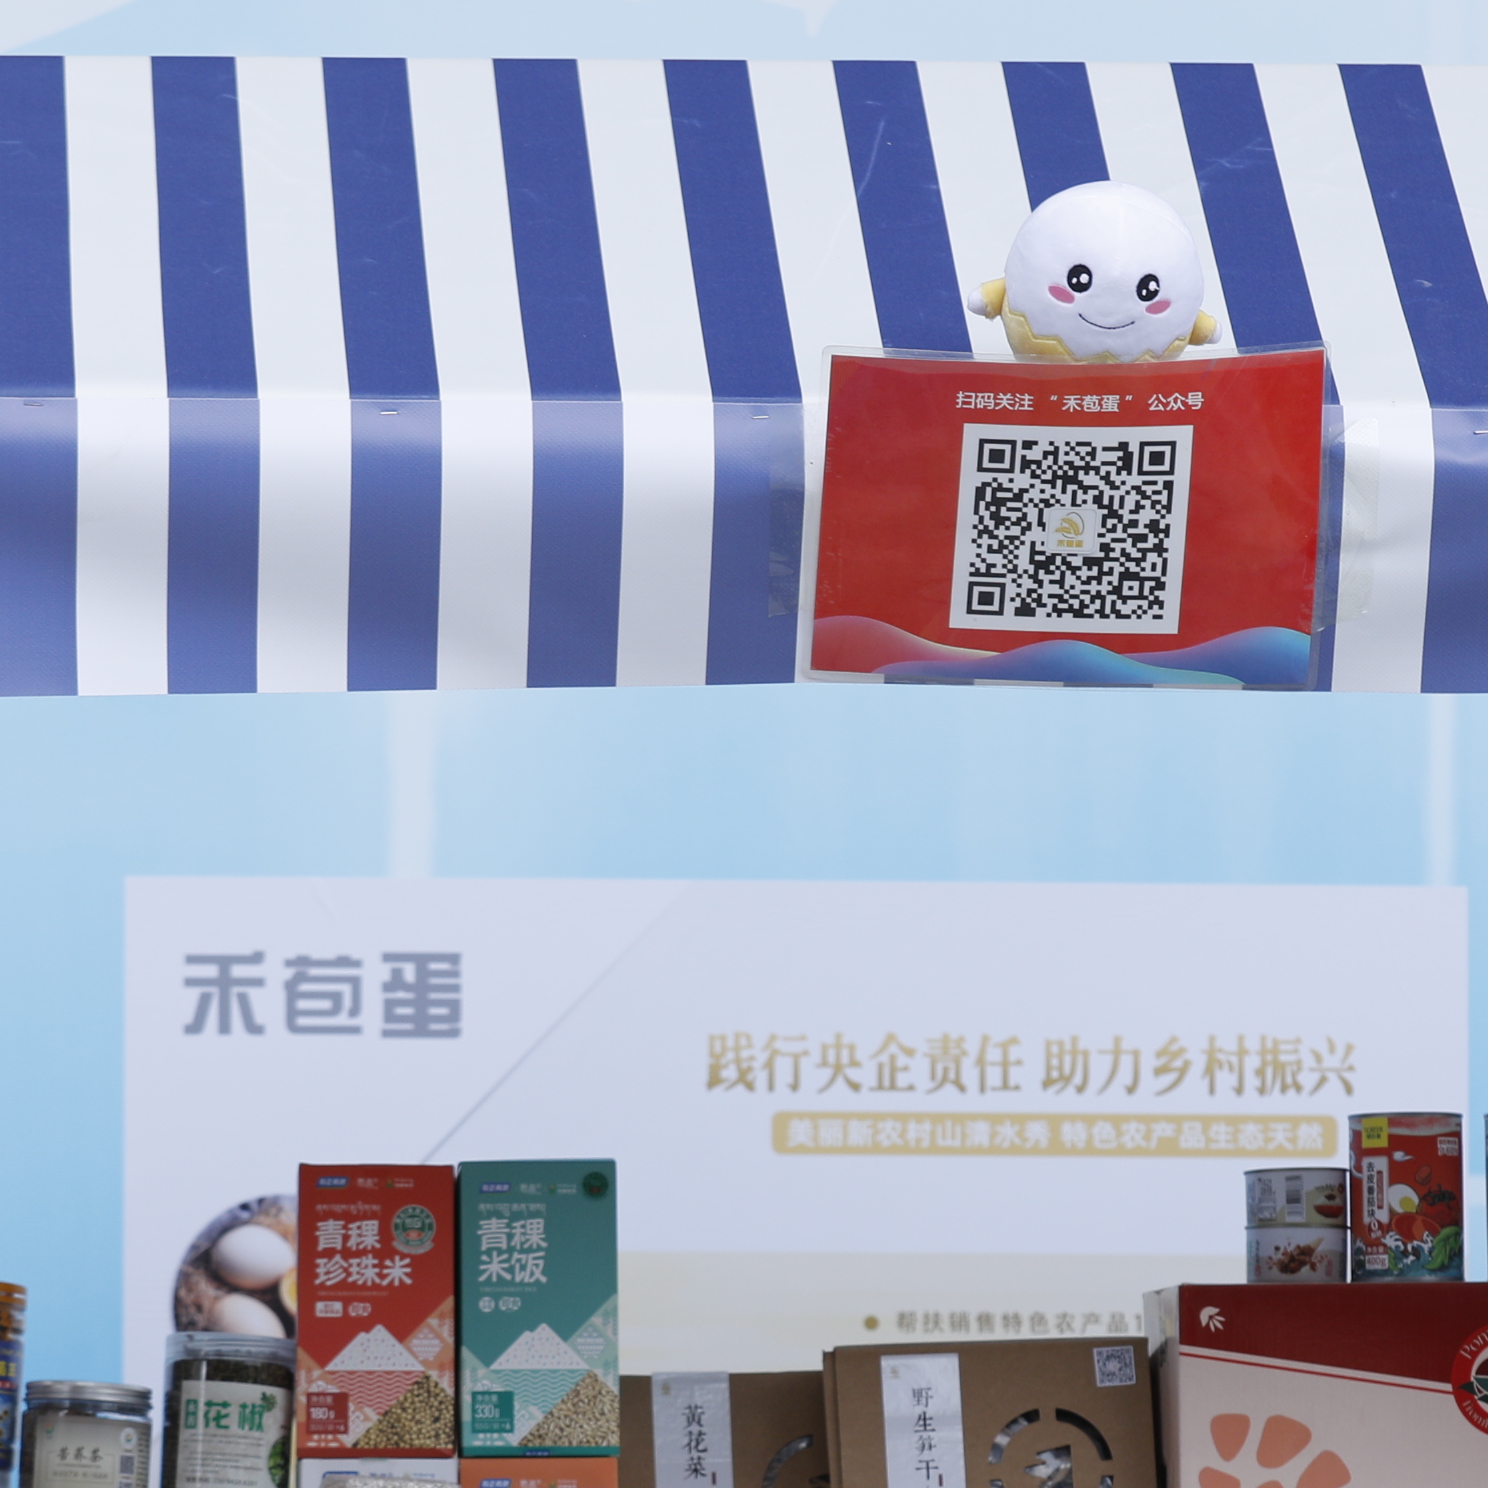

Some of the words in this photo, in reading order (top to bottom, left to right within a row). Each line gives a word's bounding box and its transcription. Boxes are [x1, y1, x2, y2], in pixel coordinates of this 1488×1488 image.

[183, 951, 462, 1038] 禾苞蛋
[706, 1030, 1023, 1096] 践行央企责任
[1042, 1033, 1357, 1097] 助力乡村振兴
[315, 1219, 381, 1251] 青稞
[478, 1218, 548, 1250] 青稞
[314, 1254, 412, 1287] 珍珠米
[478, 1251, 548, 1284] 米饭
[204, 1400, 266, 1433] 花椒
[682, 1404, 708, 1480] 黄花菜
